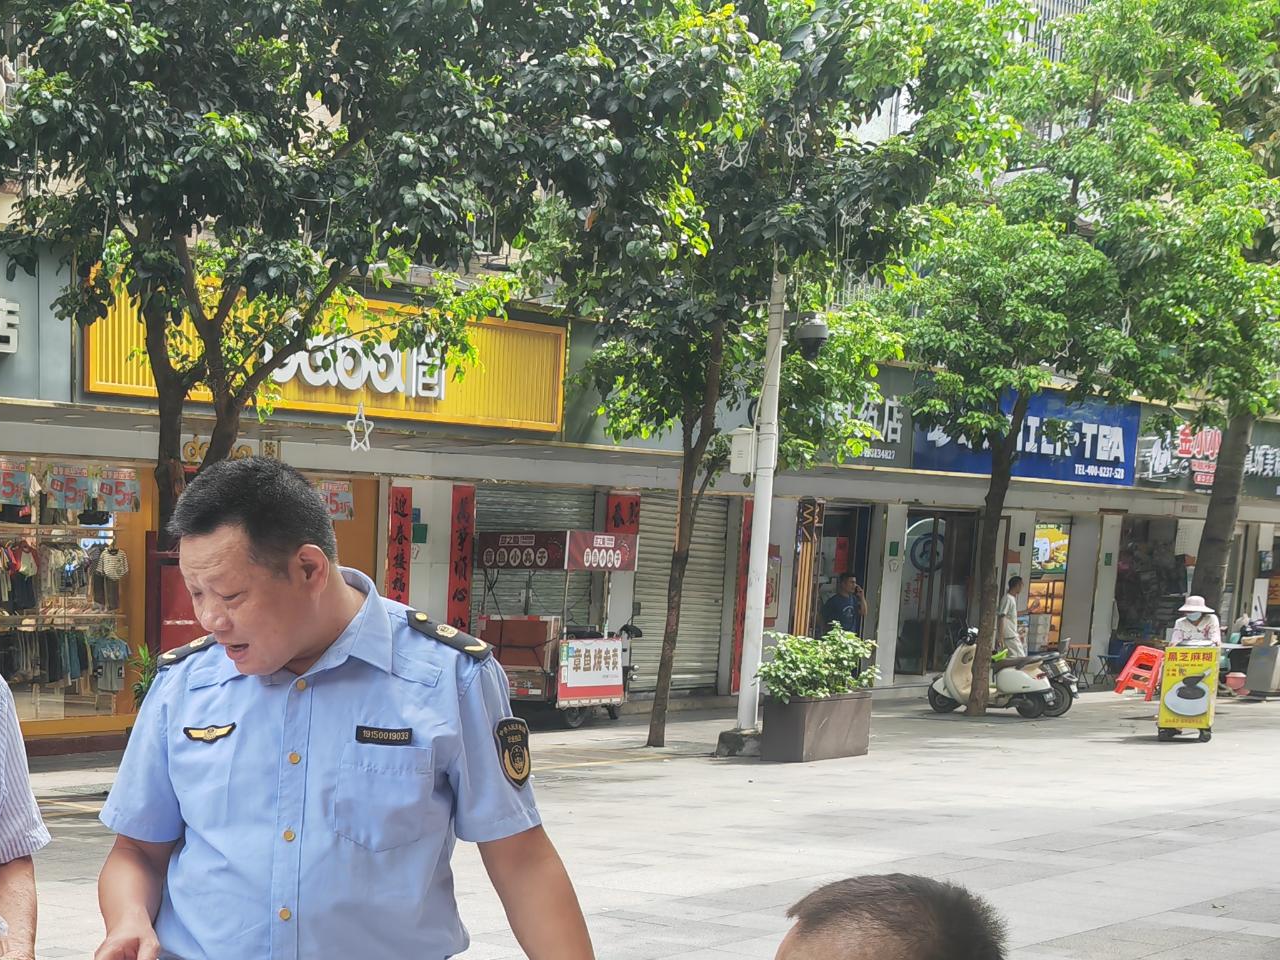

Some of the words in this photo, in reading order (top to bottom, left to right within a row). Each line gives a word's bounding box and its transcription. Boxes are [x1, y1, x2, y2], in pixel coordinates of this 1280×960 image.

[482, 547, 549, 567] 章鱼小丸子
[583, 547, 622, 568] 章鱼小丸子
[1167, 651, 1213, 662] 黑芝麻糊
